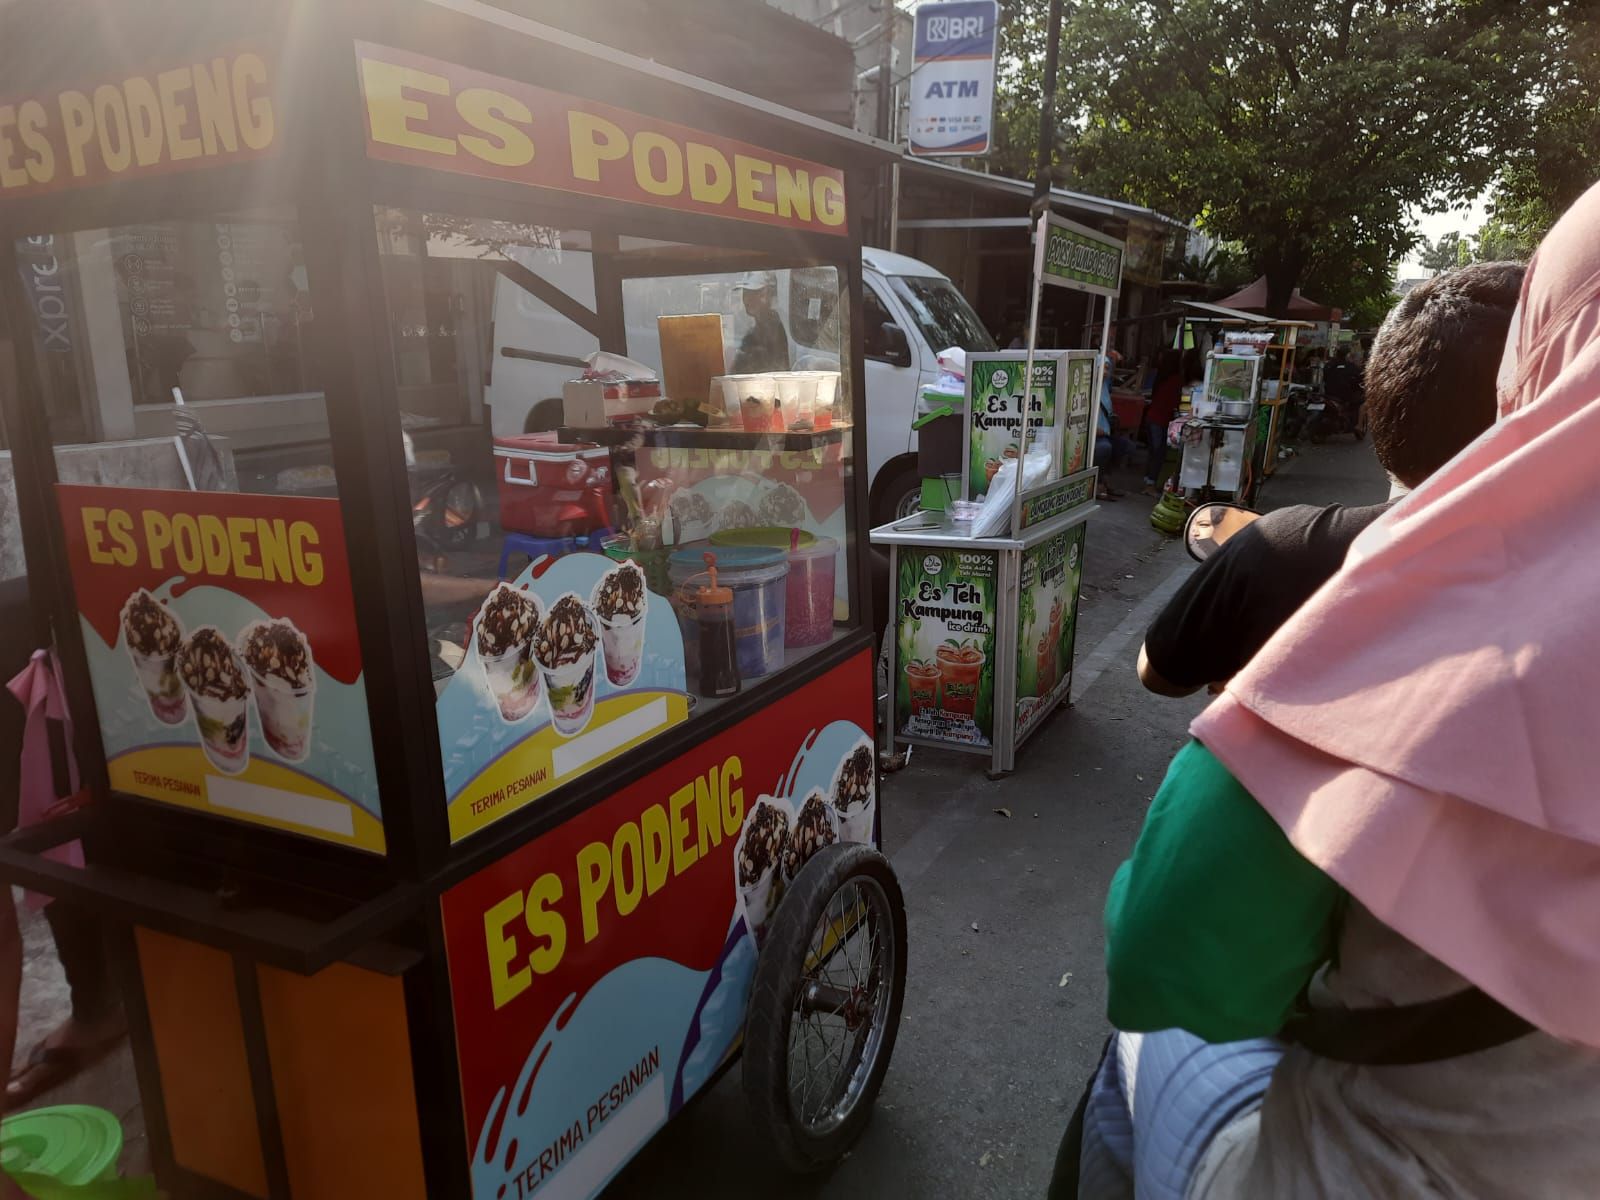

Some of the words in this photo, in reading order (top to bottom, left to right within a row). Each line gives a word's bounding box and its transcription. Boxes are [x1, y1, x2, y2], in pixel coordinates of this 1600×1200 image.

[925, 80, 979, 99] ATM
[0, 100, 55, 188] ES
[58, 53, 275, 177] PODENG
[361, 57, 535, 166] ES
[567, 110, 845, 227] PODENG
[987, 395, 1008, 413] Es
[1012, 394, 1042, 413] Th
[81, 506, 138, 567] ES
[142, 510, 324, 586] PODENG
[958, 554, 993, 566] 100%
[902, 598, 983, 626] Kampung
[918, 581, 942, 602] Es
[946, 582, 981, 605] Teh
[963, 623, 990, 634] drink
[470, 788, 505, 817] TERIMA
[506, 767, 547, 798] PESANAN
[484, 872, 567, 1011] ES
[576, 755, 744, 944] PODENG
[513, 1119, 584, 1200] TERIMA
[586, 1045, 660, 1134] PESANAN
